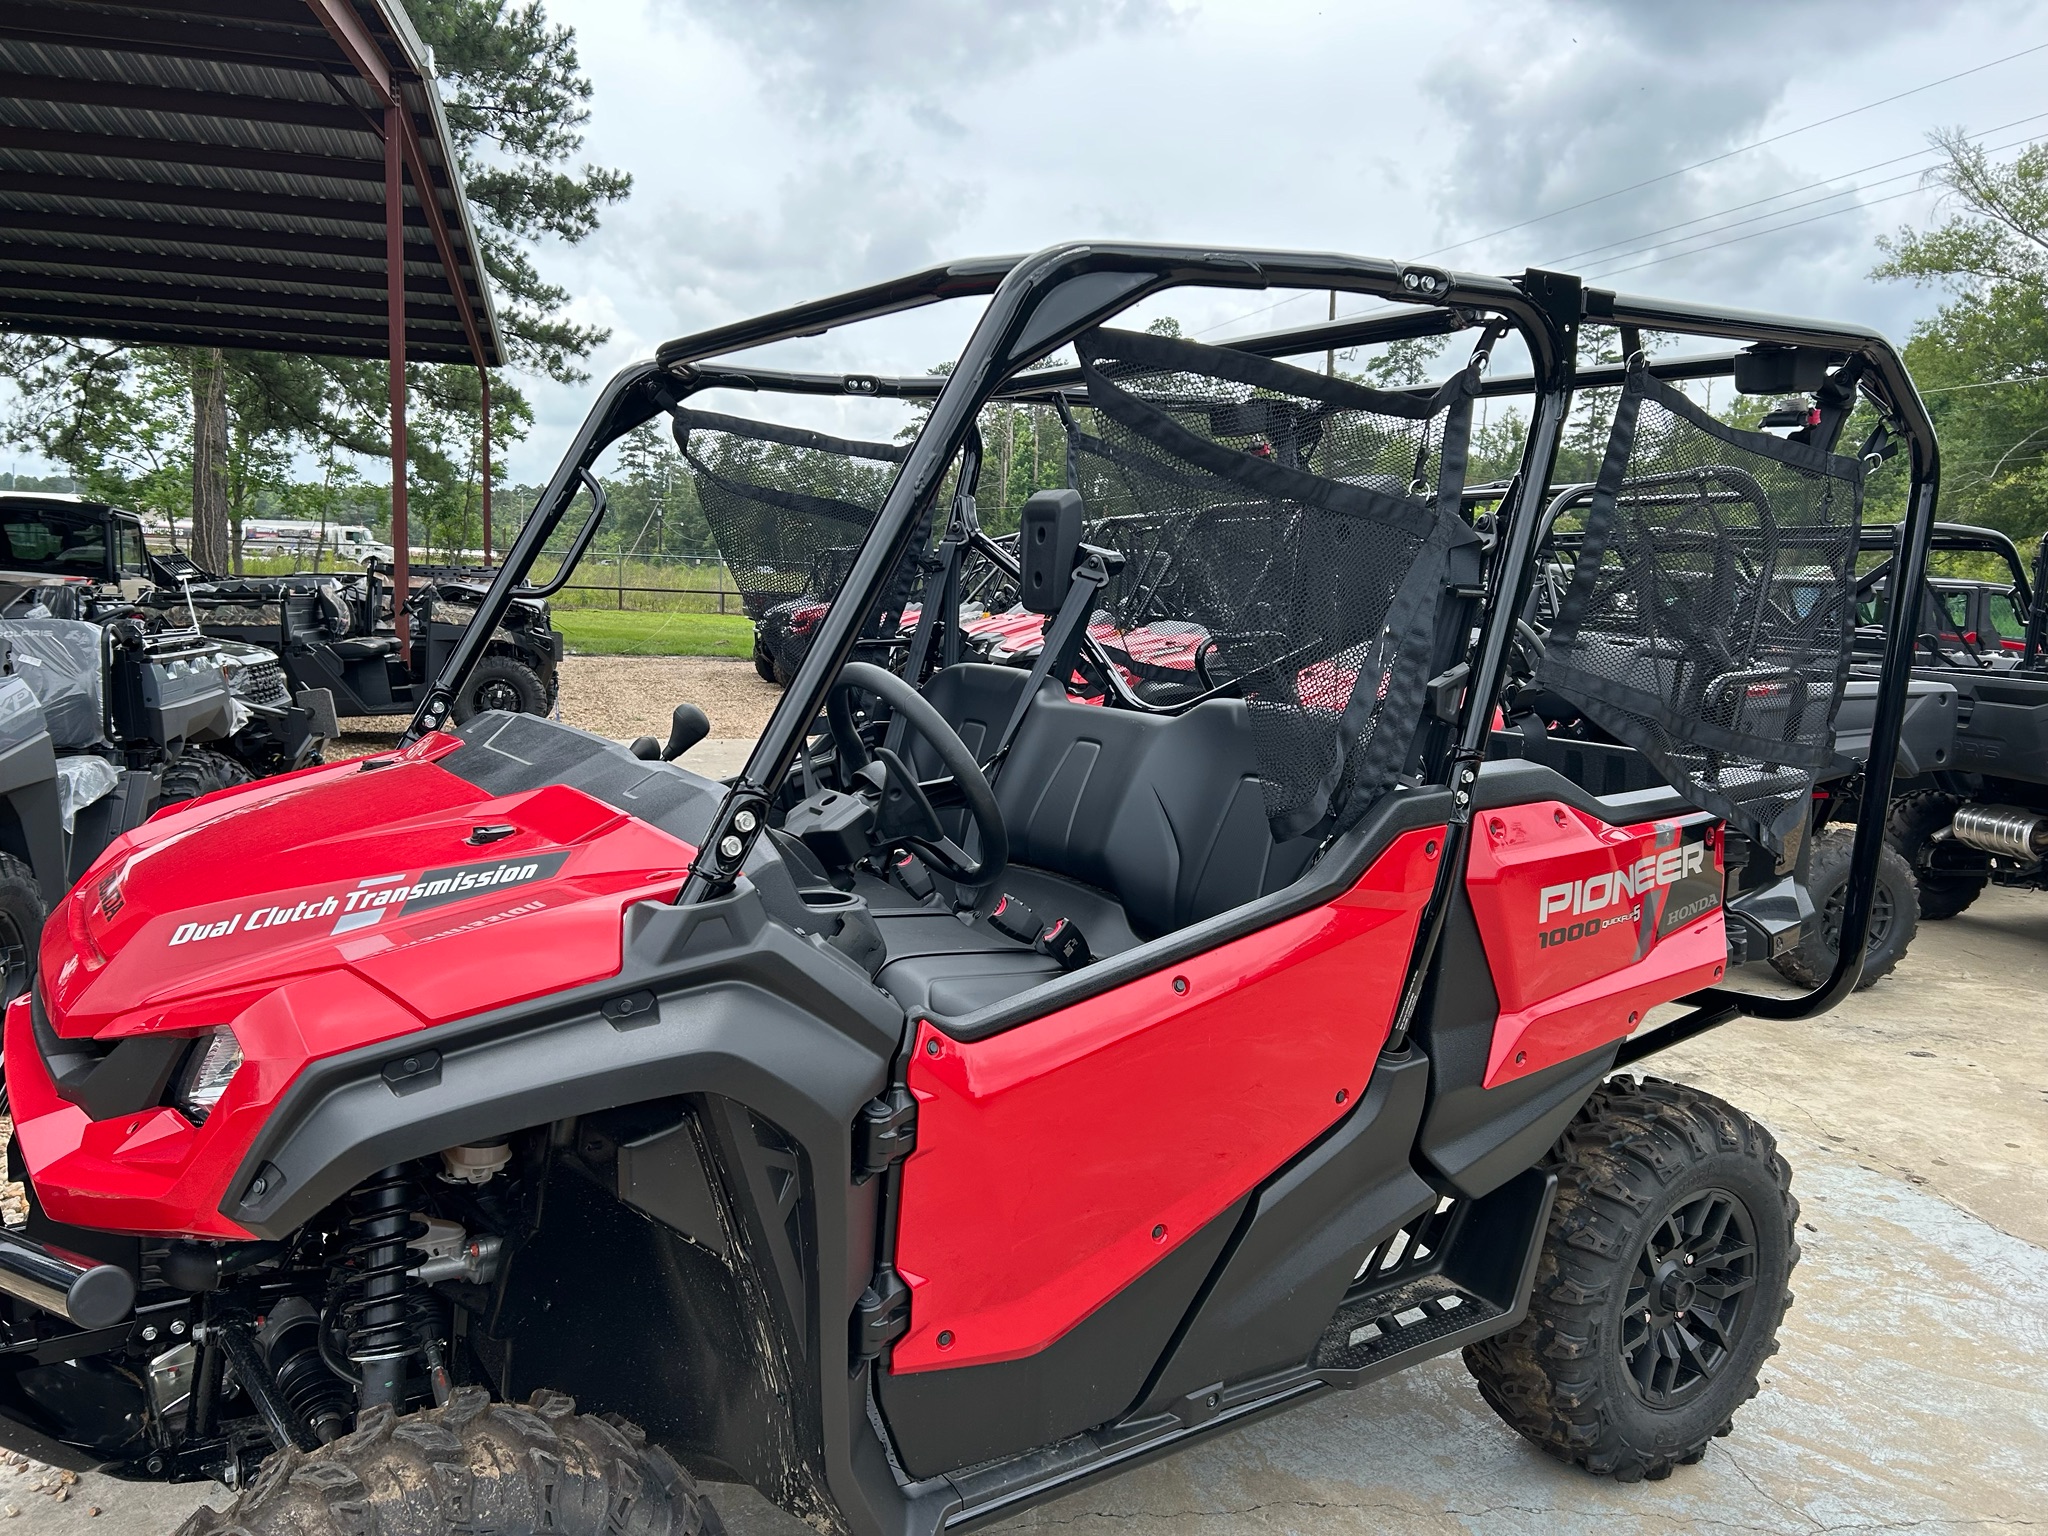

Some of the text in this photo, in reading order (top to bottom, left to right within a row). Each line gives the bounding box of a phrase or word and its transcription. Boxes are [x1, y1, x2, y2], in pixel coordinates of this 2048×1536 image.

[168, 862, 539, 947] Dual Clutch Transmission
[1539, 840, 1705, 925] PIONEER
[1667, 893, 1719, 926] HONDA
[1539, 917, 1601, 949] 1000
